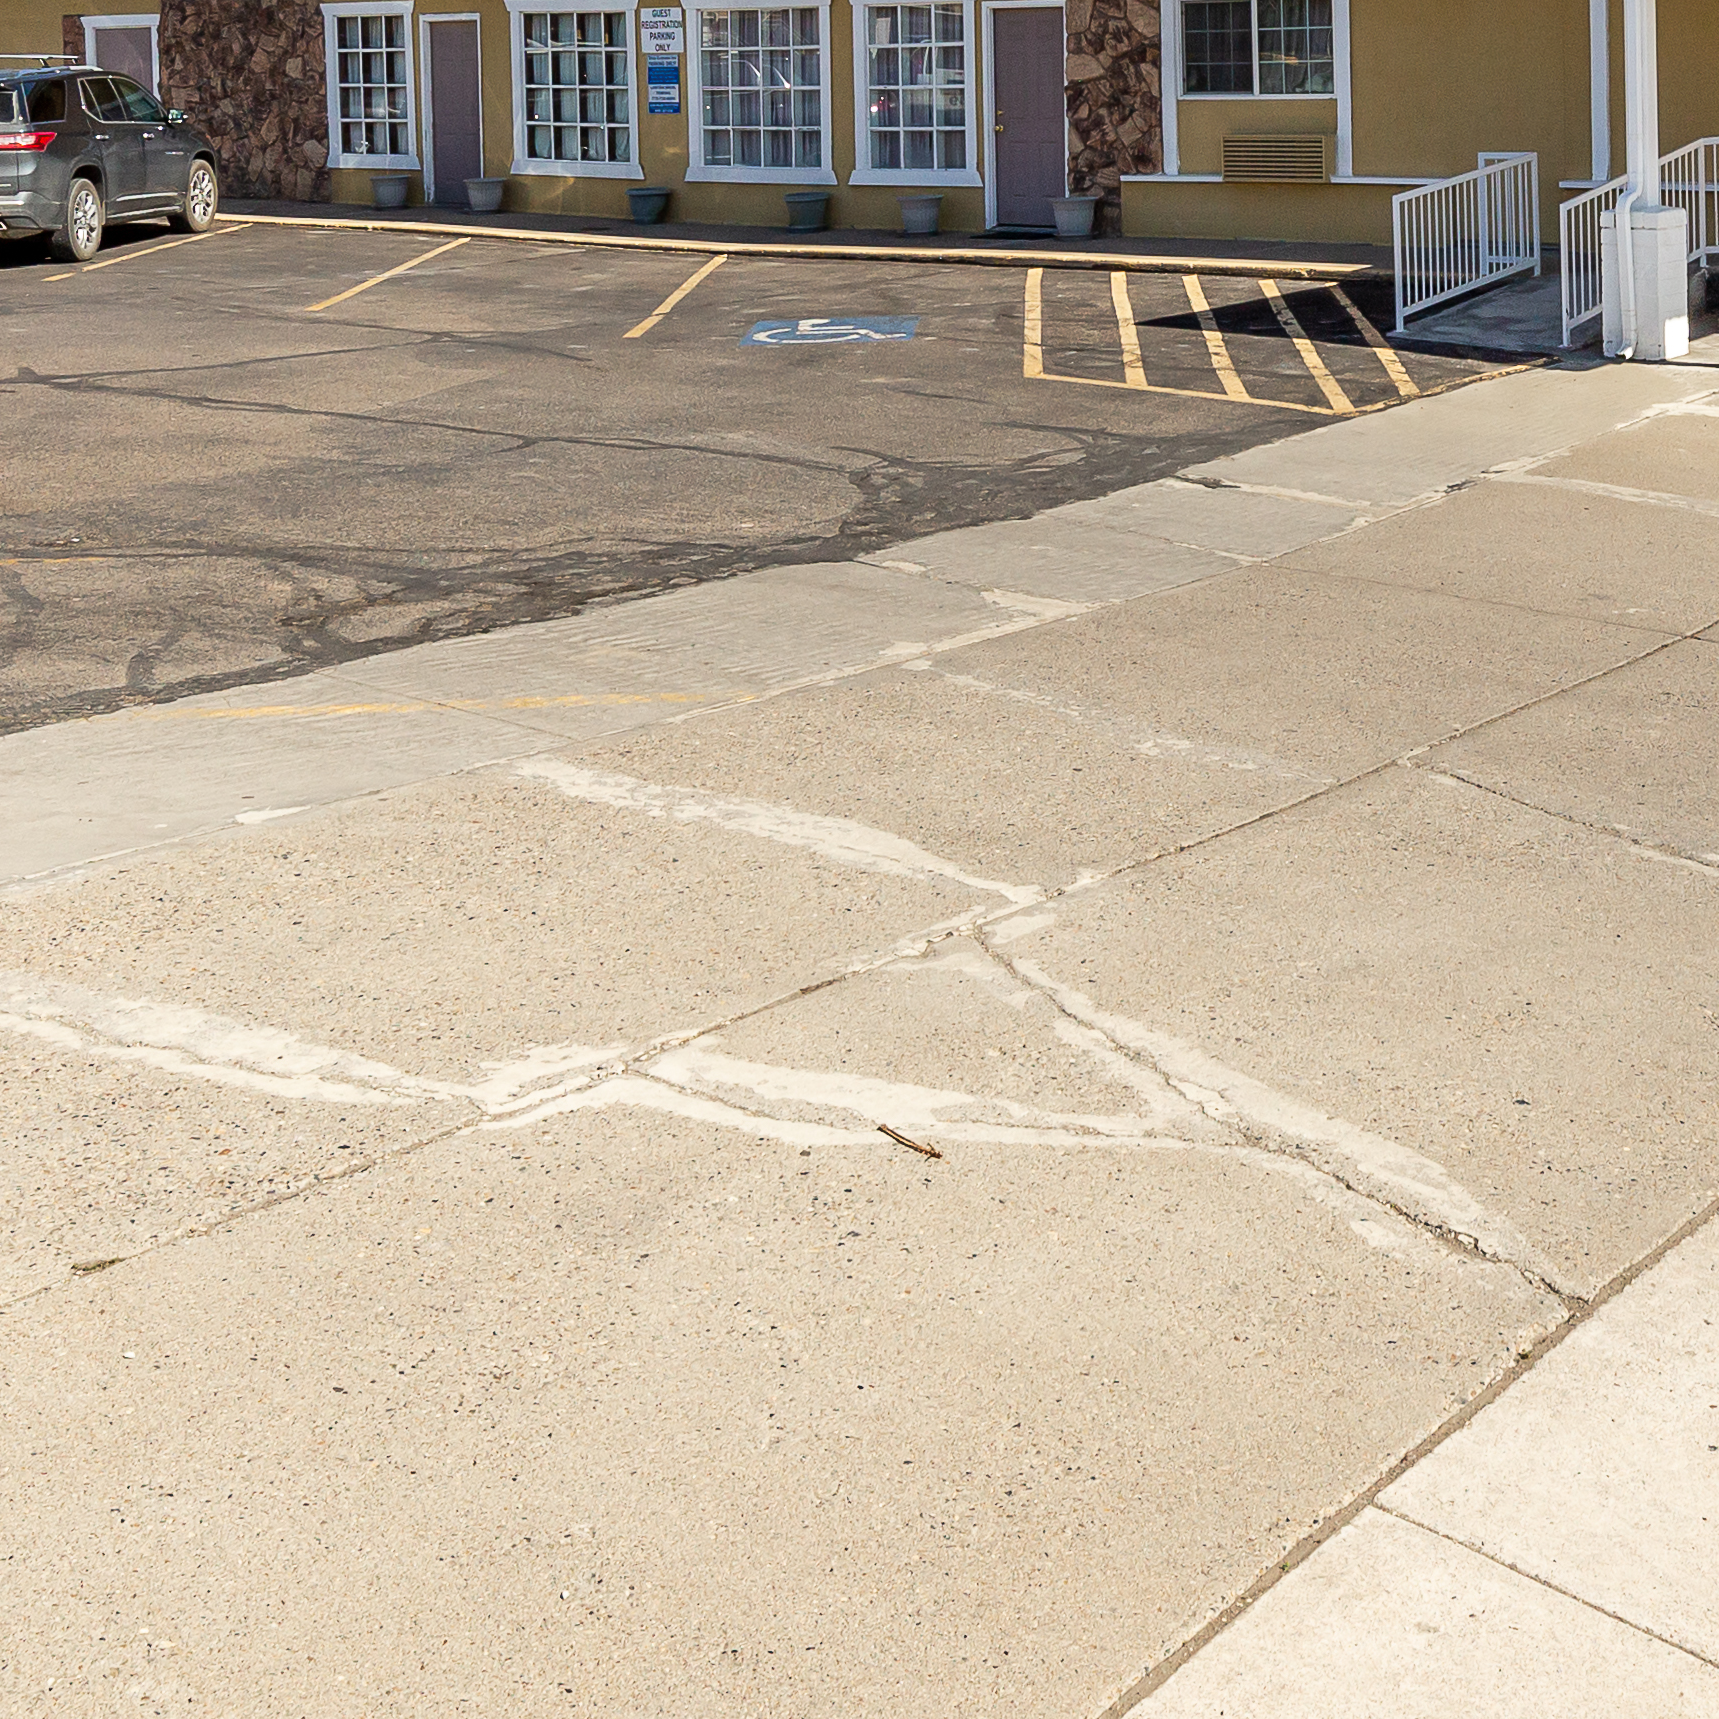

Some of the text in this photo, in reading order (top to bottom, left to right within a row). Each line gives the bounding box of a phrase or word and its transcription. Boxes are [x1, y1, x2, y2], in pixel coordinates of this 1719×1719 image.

[651, 8, 672, 18] GUEST
[641, 20, 683, 30] REGISTRATION
[649, 31, 676, 41] PARKING
[654, 43, 671, 52] ONLY
